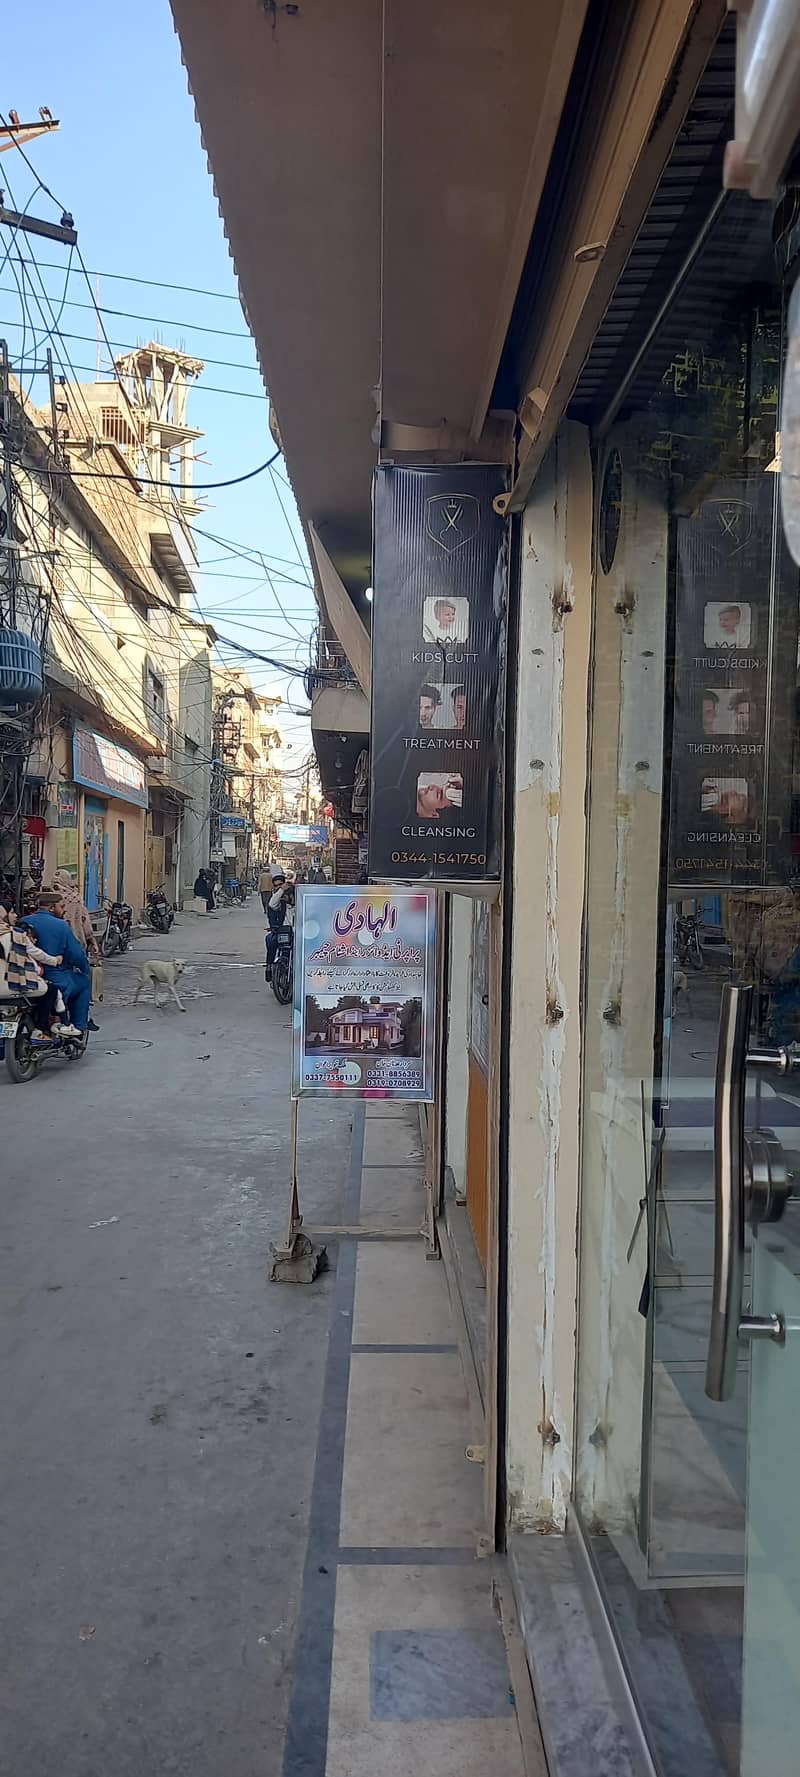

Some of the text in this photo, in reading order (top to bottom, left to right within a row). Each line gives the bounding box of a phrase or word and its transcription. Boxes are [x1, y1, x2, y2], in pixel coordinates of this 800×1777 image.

[412, 652, 478, 664] KIDS CUTT
[403, 738, 481, 750] TREATMENT
[401, 825, 476, 838] CLEANSING
[391, 852, 487, 865] 0344-1541750
[334, 900, 397, 939] الہادی
